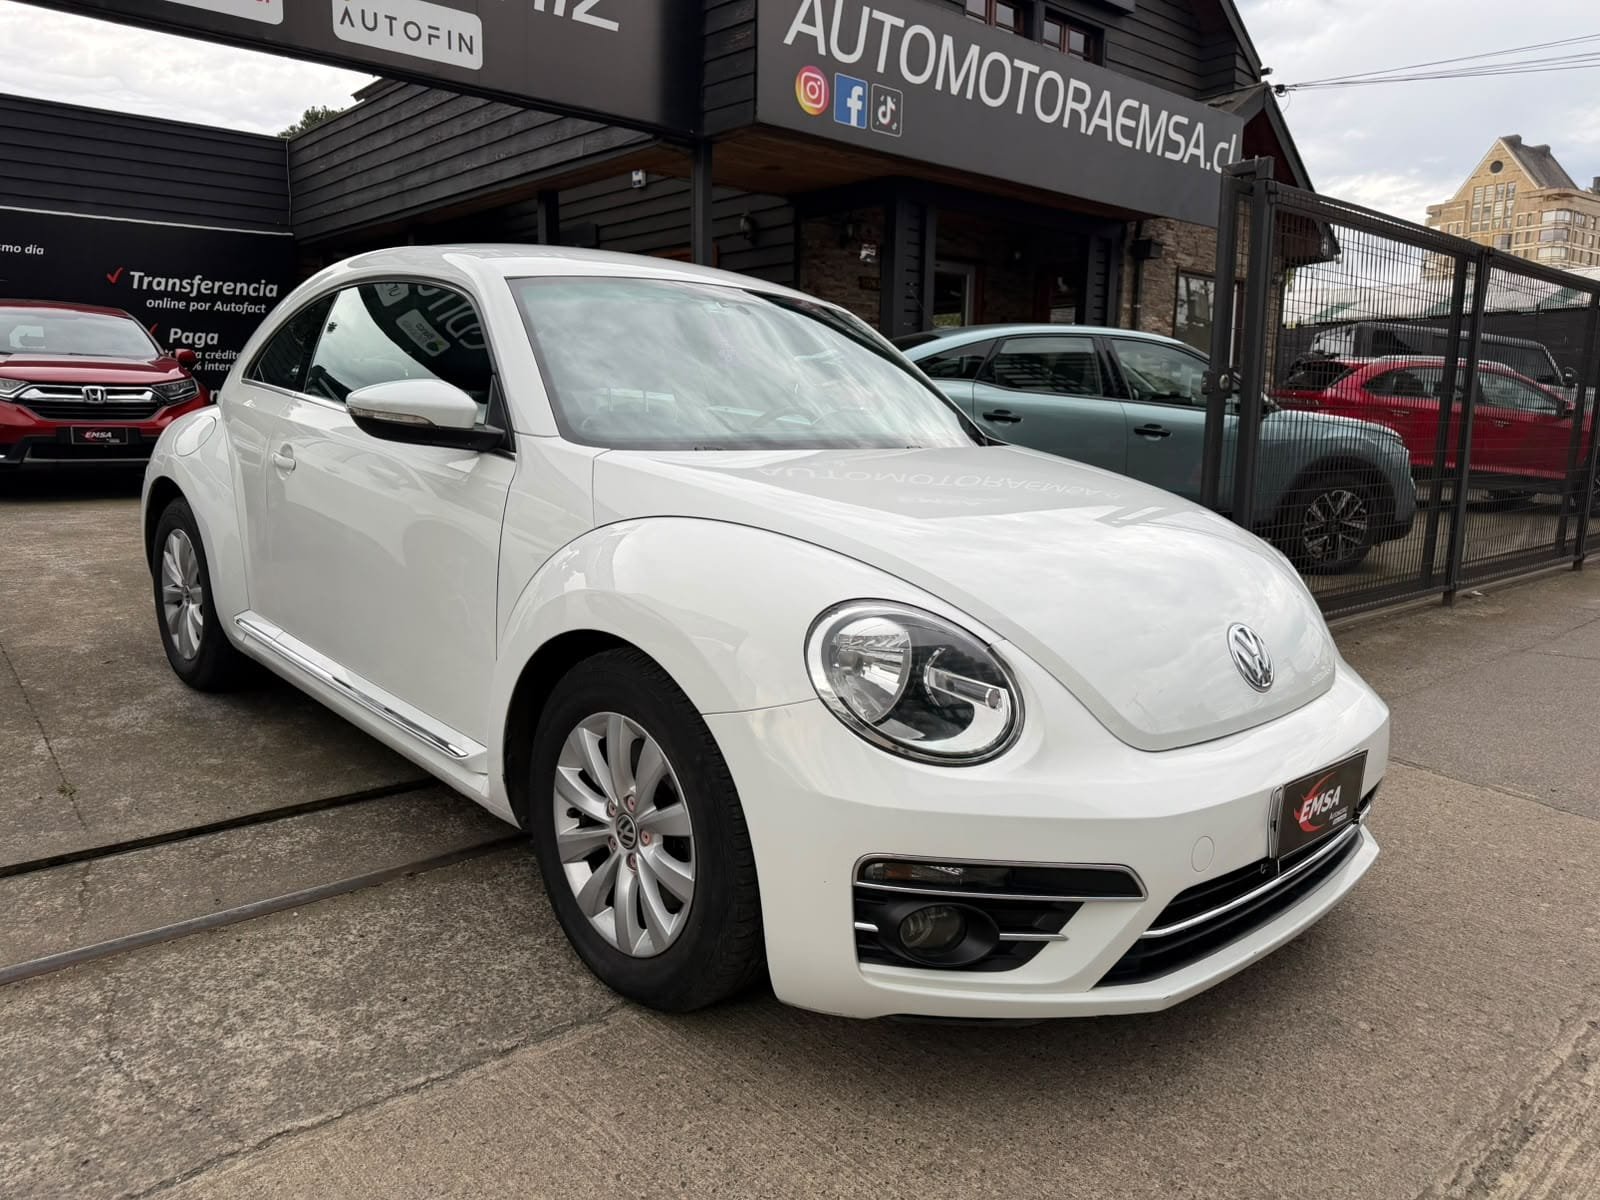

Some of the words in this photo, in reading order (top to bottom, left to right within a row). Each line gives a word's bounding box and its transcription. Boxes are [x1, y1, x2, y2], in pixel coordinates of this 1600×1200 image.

[340, 6, 474, 55] AUTOFIN
[0, 244, 22, 253] mo
[25, 244, 45, 255] día
[130, 271, 278, 298] Transferencia
[146, 298, 186, 310] online
[189, 300, 211, 312] por
[213, 301, 266, 315] Autofact
[168, 327, 219, 348] Paga
[1299, 785, 1341, 824] EMSA
